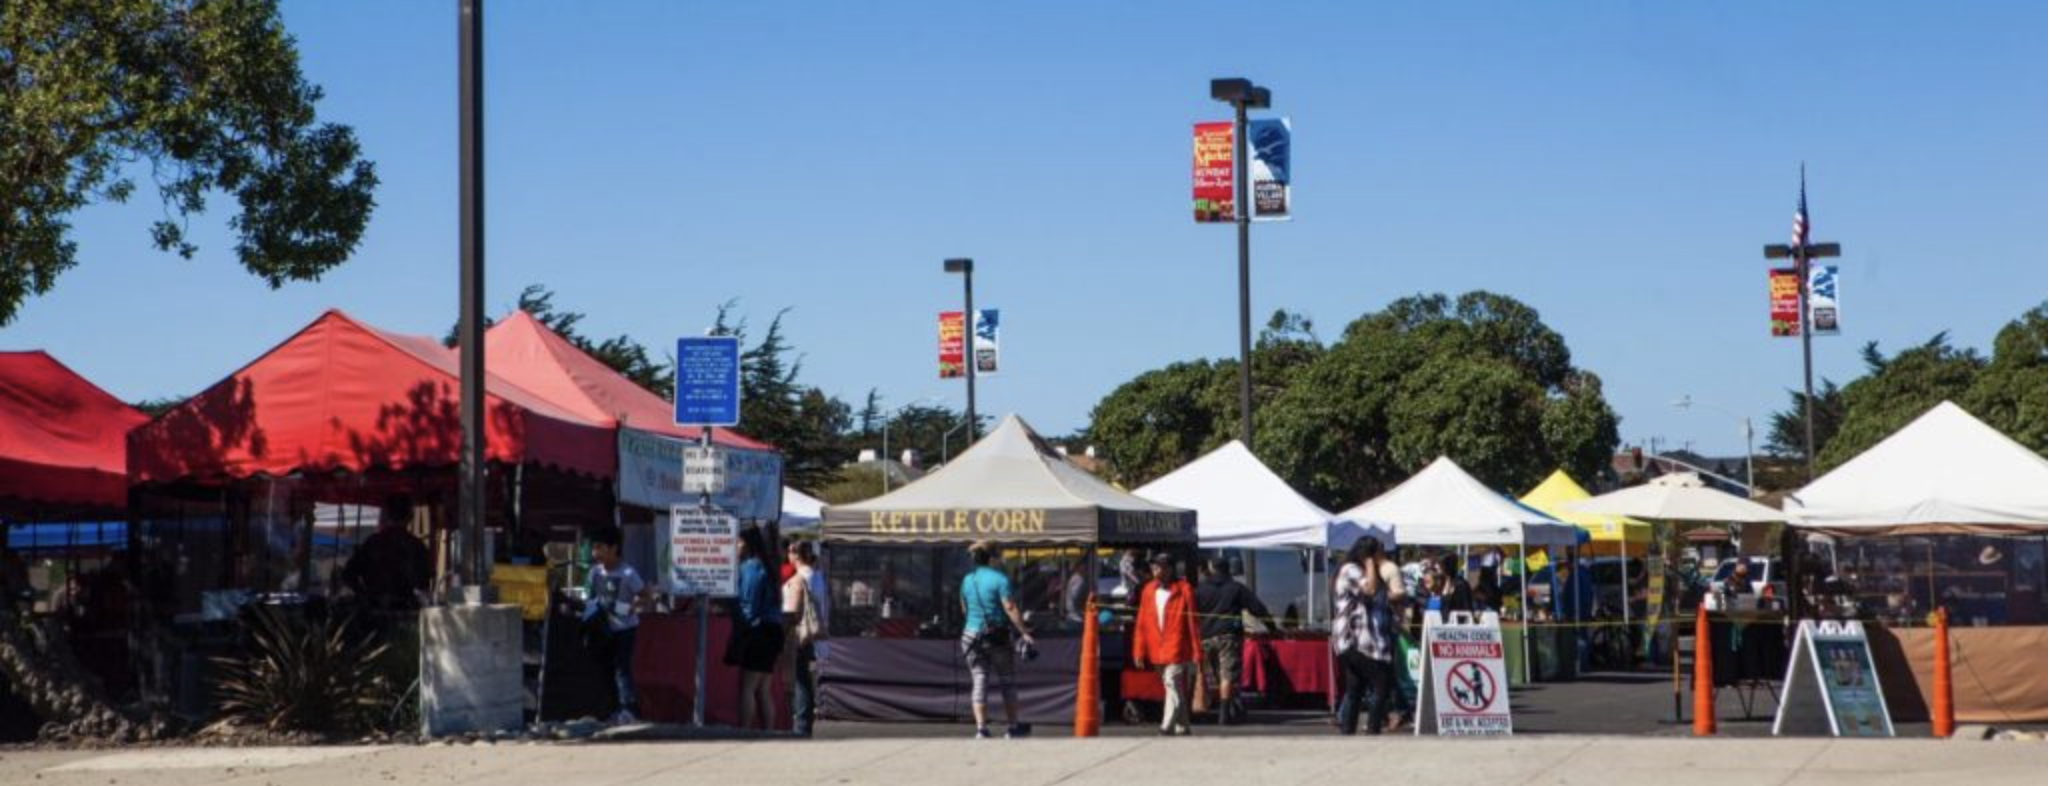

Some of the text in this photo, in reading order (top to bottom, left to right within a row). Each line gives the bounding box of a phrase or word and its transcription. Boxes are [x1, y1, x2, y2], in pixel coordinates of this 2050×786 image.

[870, 511, 1045, 533] KETTLE CORN
[1437, 630, 1468, 640] HEALTH
[1439, 644, 1497, 657] NO ANIMALS
